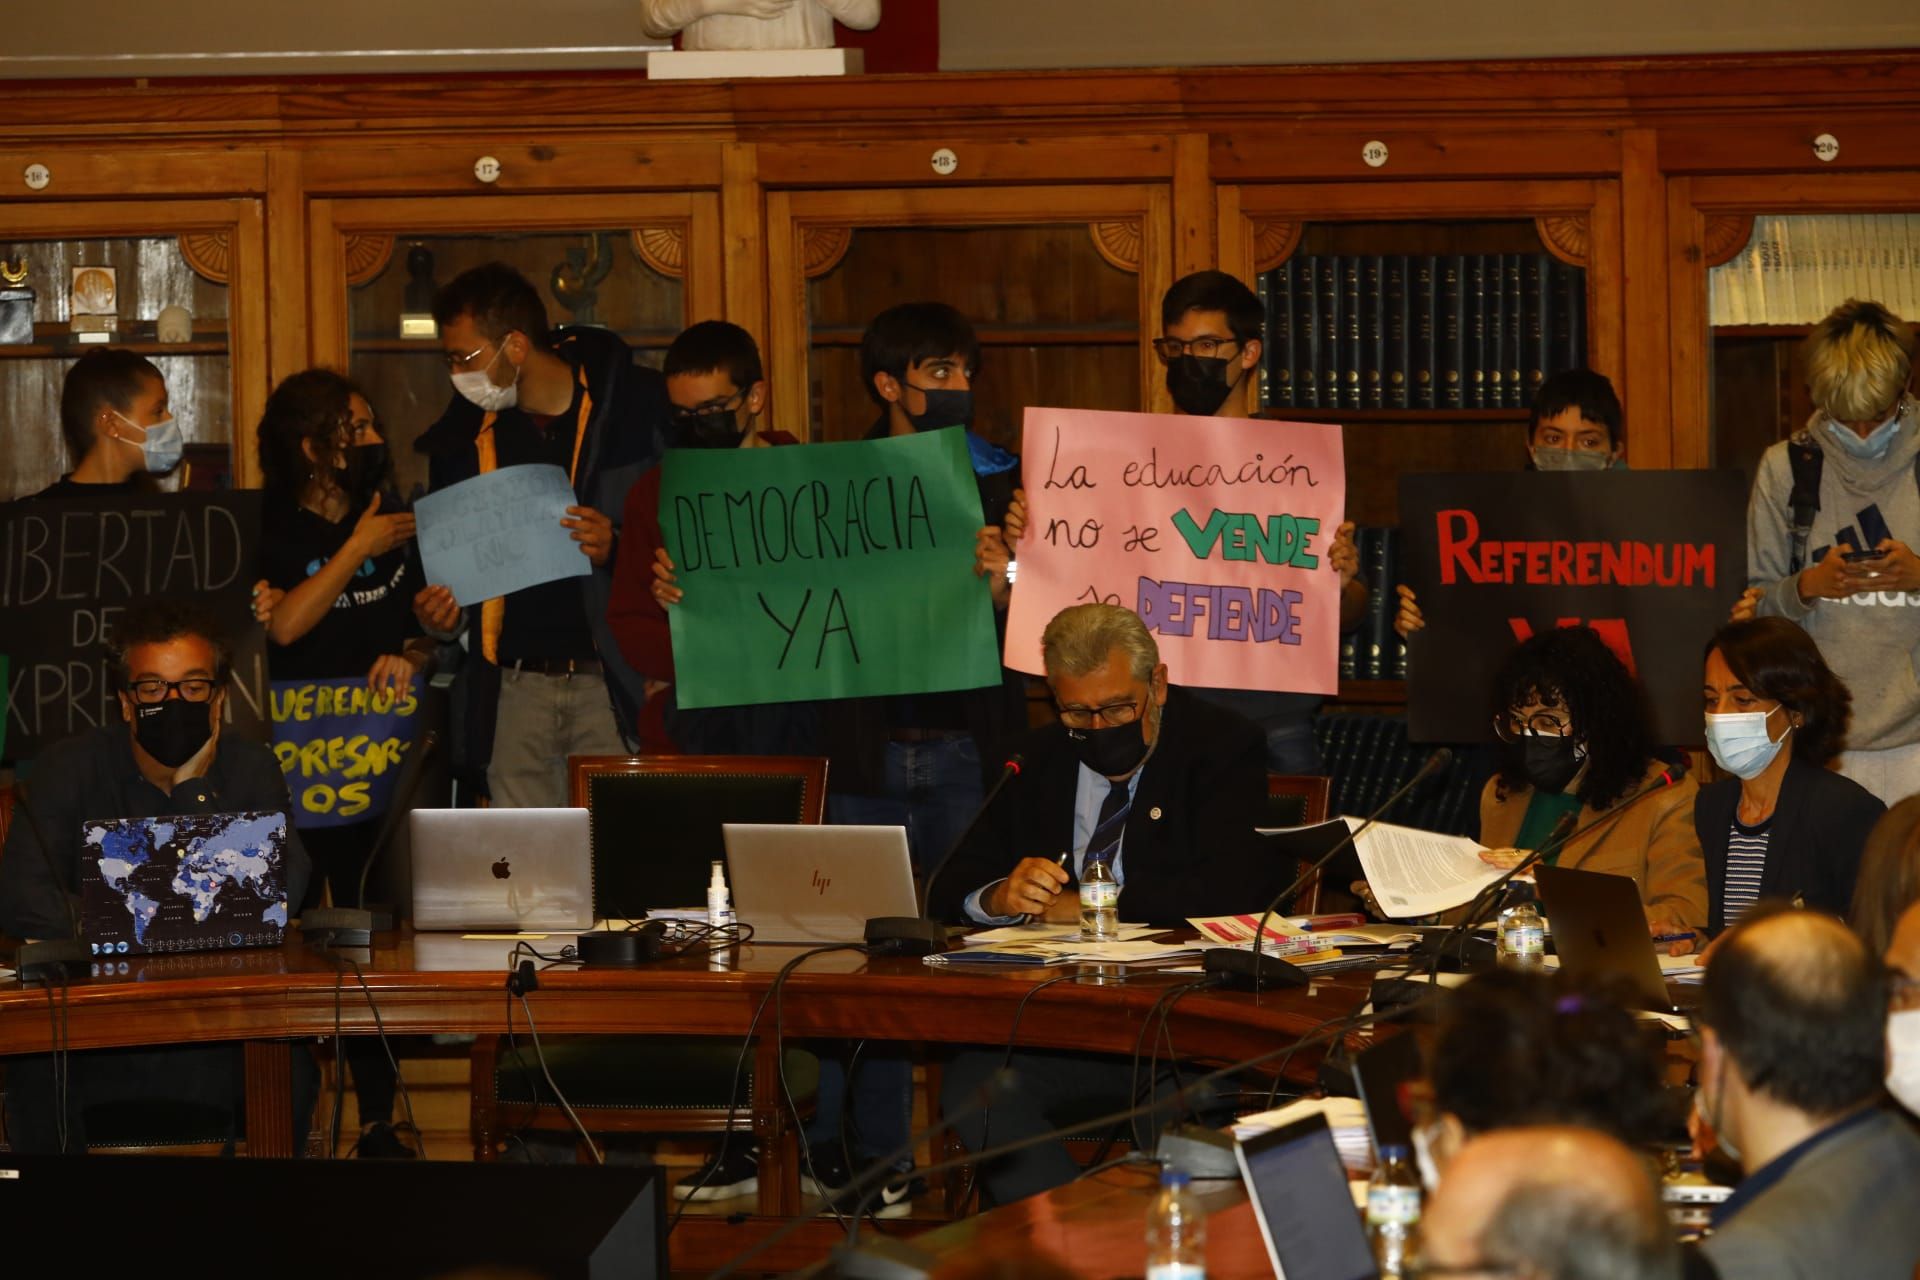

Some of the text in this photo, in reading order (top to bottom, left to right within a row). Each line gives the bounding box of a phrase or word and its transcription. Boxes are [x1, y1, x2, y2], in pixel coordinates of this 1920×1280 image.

[482, 164, 493, 175] 17
[938, 156, 950, 167] 18
[1369, 149, 1381, 160] 19
[1820, 142, 1833, 153] 20
[1044, 425, 1319, 489] La educación
[675, 474, 937, 573] DEMOCRACIA
[1044, 508, 1320, 570] no se VENDE
[1436, 509, 1716, 589] REFERENDUM
[72, 605, 127, 648] DE
[757, 588, 861, 670] YA
[1137, 576, 1304, 646] DEFIENDE
[812, 869, 831, 895] hp
